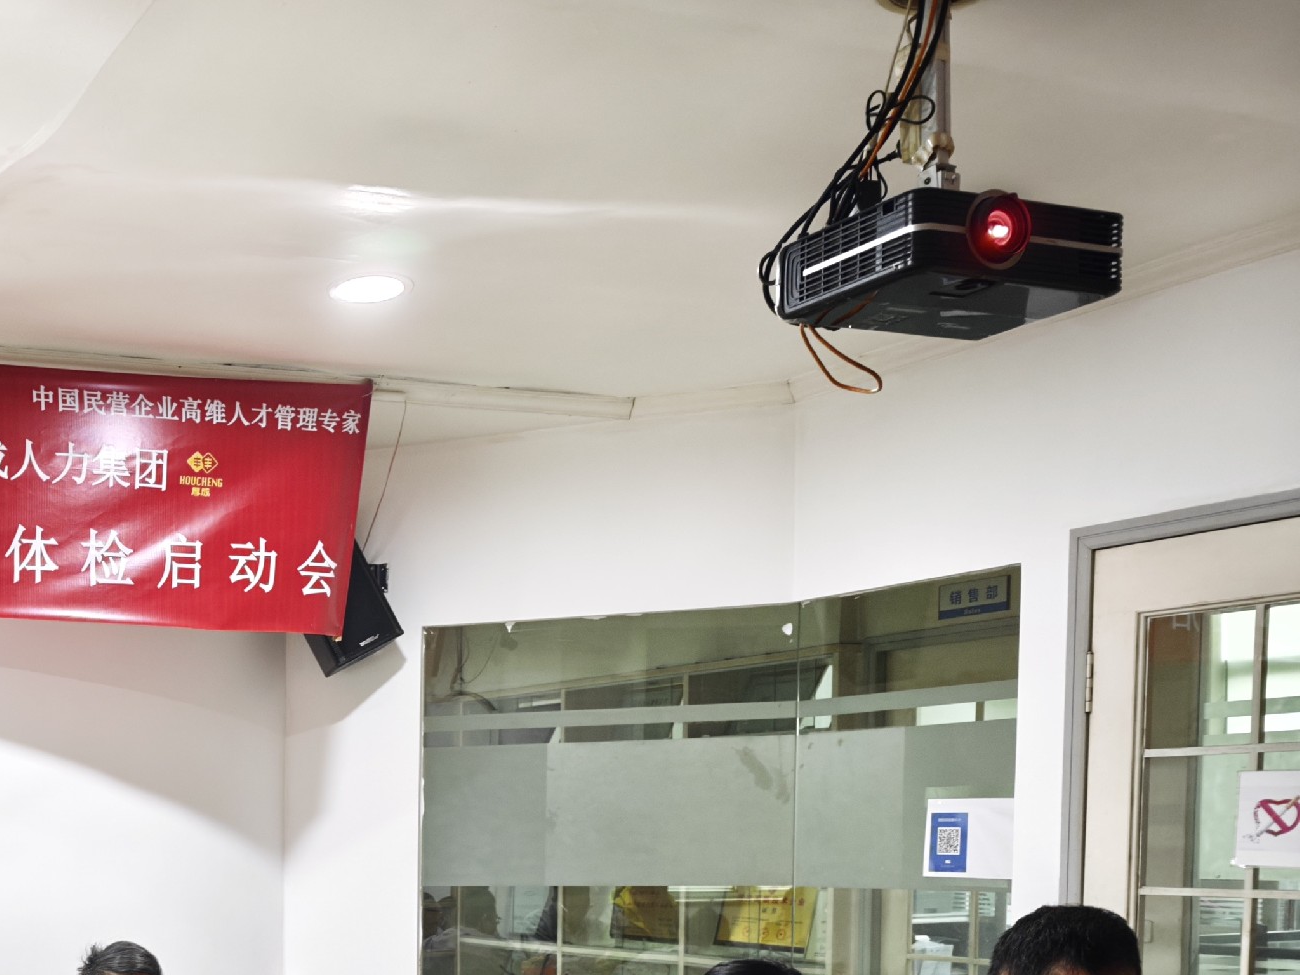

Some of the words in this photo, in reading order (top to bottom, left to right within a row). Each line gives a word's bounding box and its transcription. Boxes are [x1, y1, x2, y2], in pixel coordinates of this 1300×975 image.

[32, 384, 362, 435] 中国民营企业高维人才管理专家
[179, 475, 223, 488] HOUCHENG
[949, 585, 998, 604] 销售部
